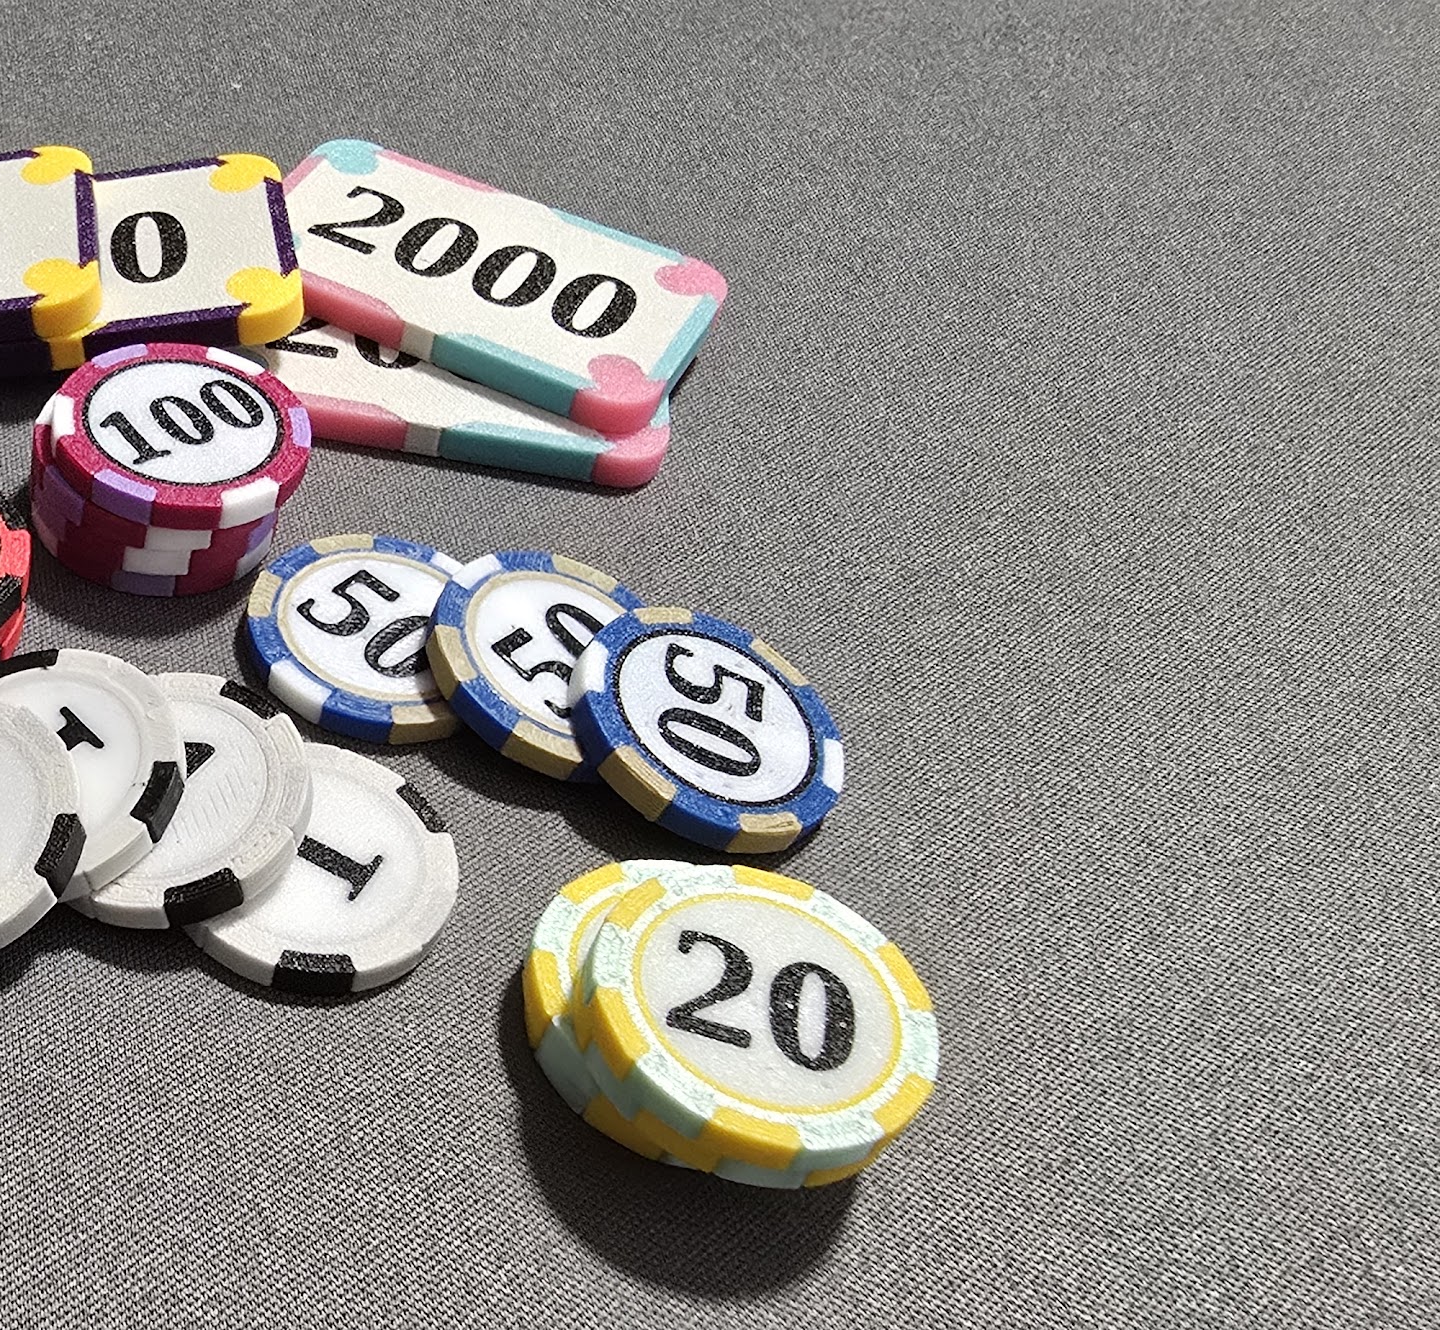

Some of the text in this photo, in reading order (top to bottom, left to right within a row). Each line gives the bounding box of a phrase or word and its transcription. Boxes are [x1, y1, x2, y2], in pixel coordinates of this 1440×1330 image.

[306, 185, 637, 339] 2000
[100, 378, 266, 466] 100
[297, 569, 434, 679] 50
[491, 602, 605, 719] 50
[657, 643, 766, 778] 50
[666, 929, 856, 1072] 20
